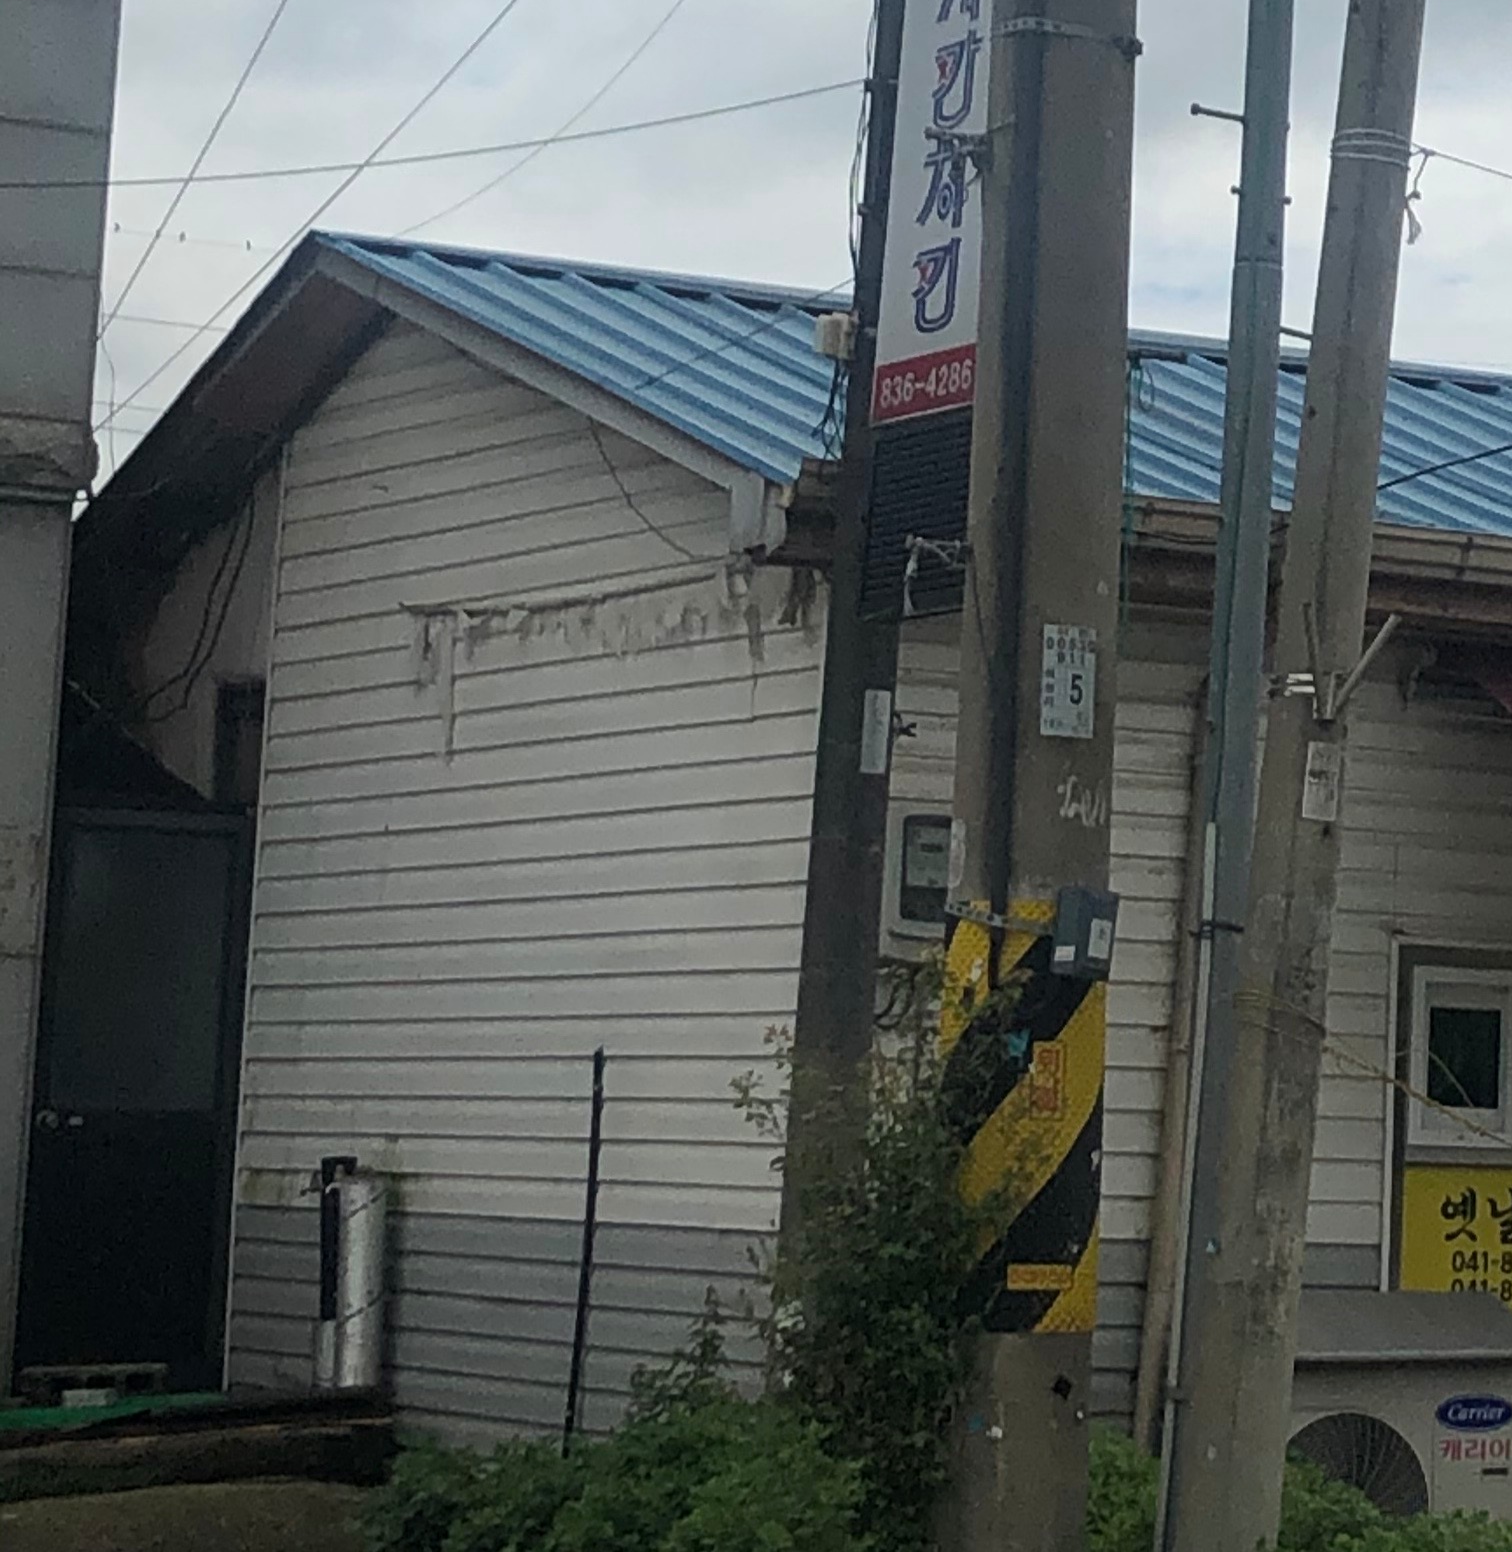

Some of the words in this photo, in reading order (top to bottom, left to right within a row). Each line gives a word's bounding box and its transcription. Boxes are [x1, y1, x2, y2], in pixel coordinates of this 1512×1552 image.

[879, 358, 973, 409] 836-4286
[1069, 673, 1083, 706] 5
[1447, 1402, 1505, 1422] Carrier
